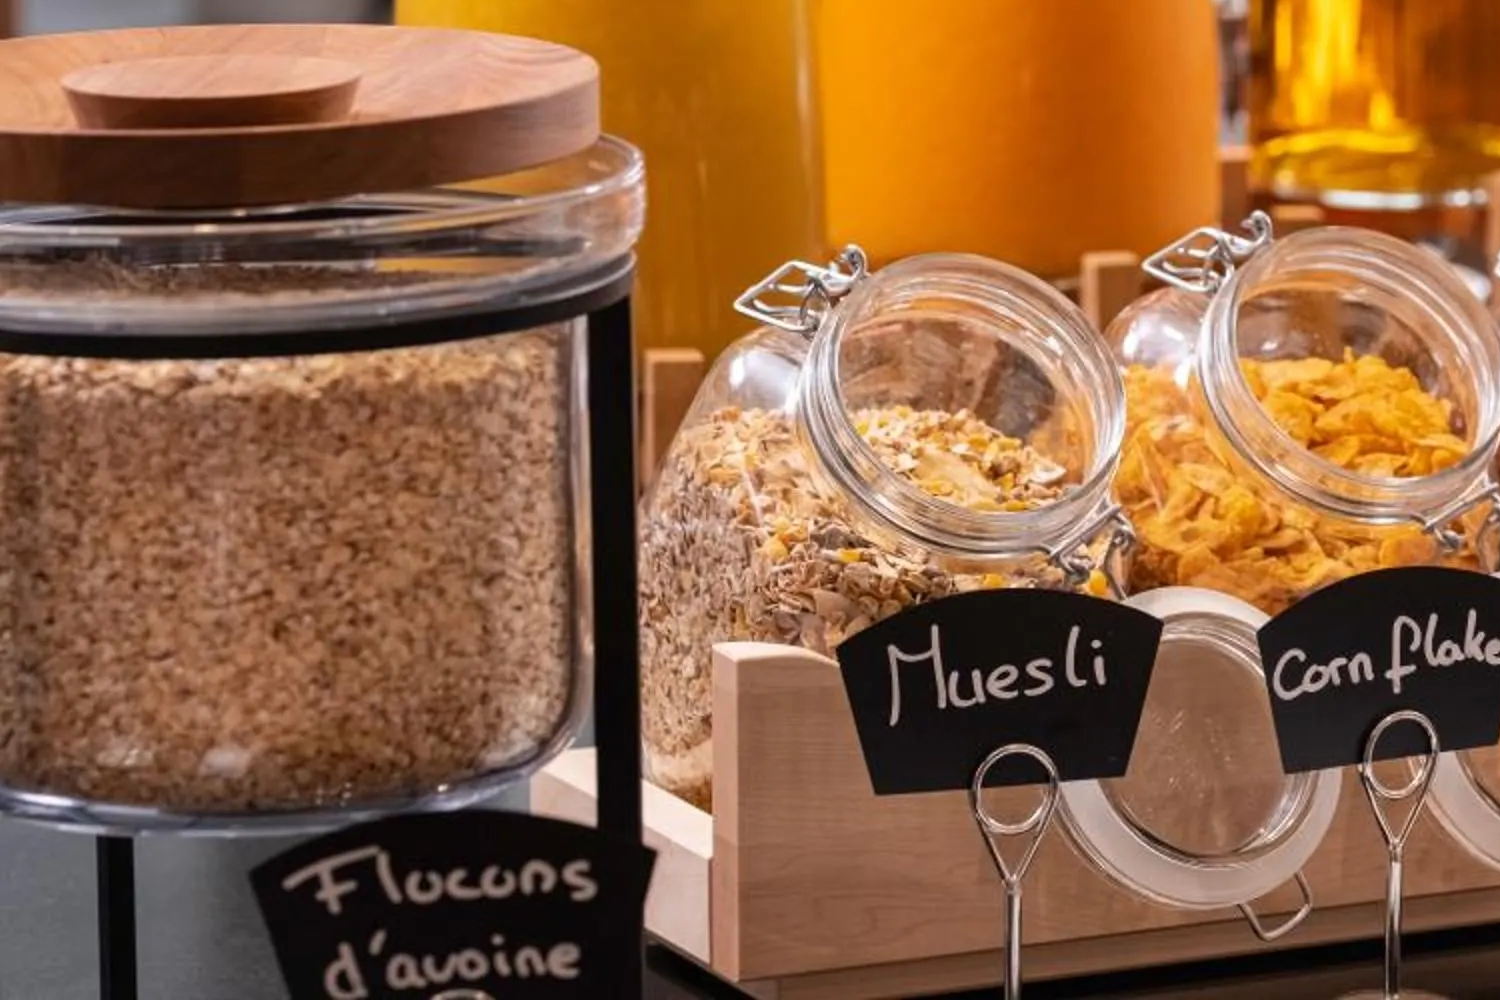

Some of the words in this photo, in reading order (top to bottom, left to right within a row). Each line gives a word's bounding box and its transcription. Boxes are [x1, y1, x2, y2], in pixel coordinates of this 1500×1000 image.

[886, 623, 1107, 727] Muesli
[281, 844, 599, 915] Flocons
[323, 928, 583, 1000] d'avoine
